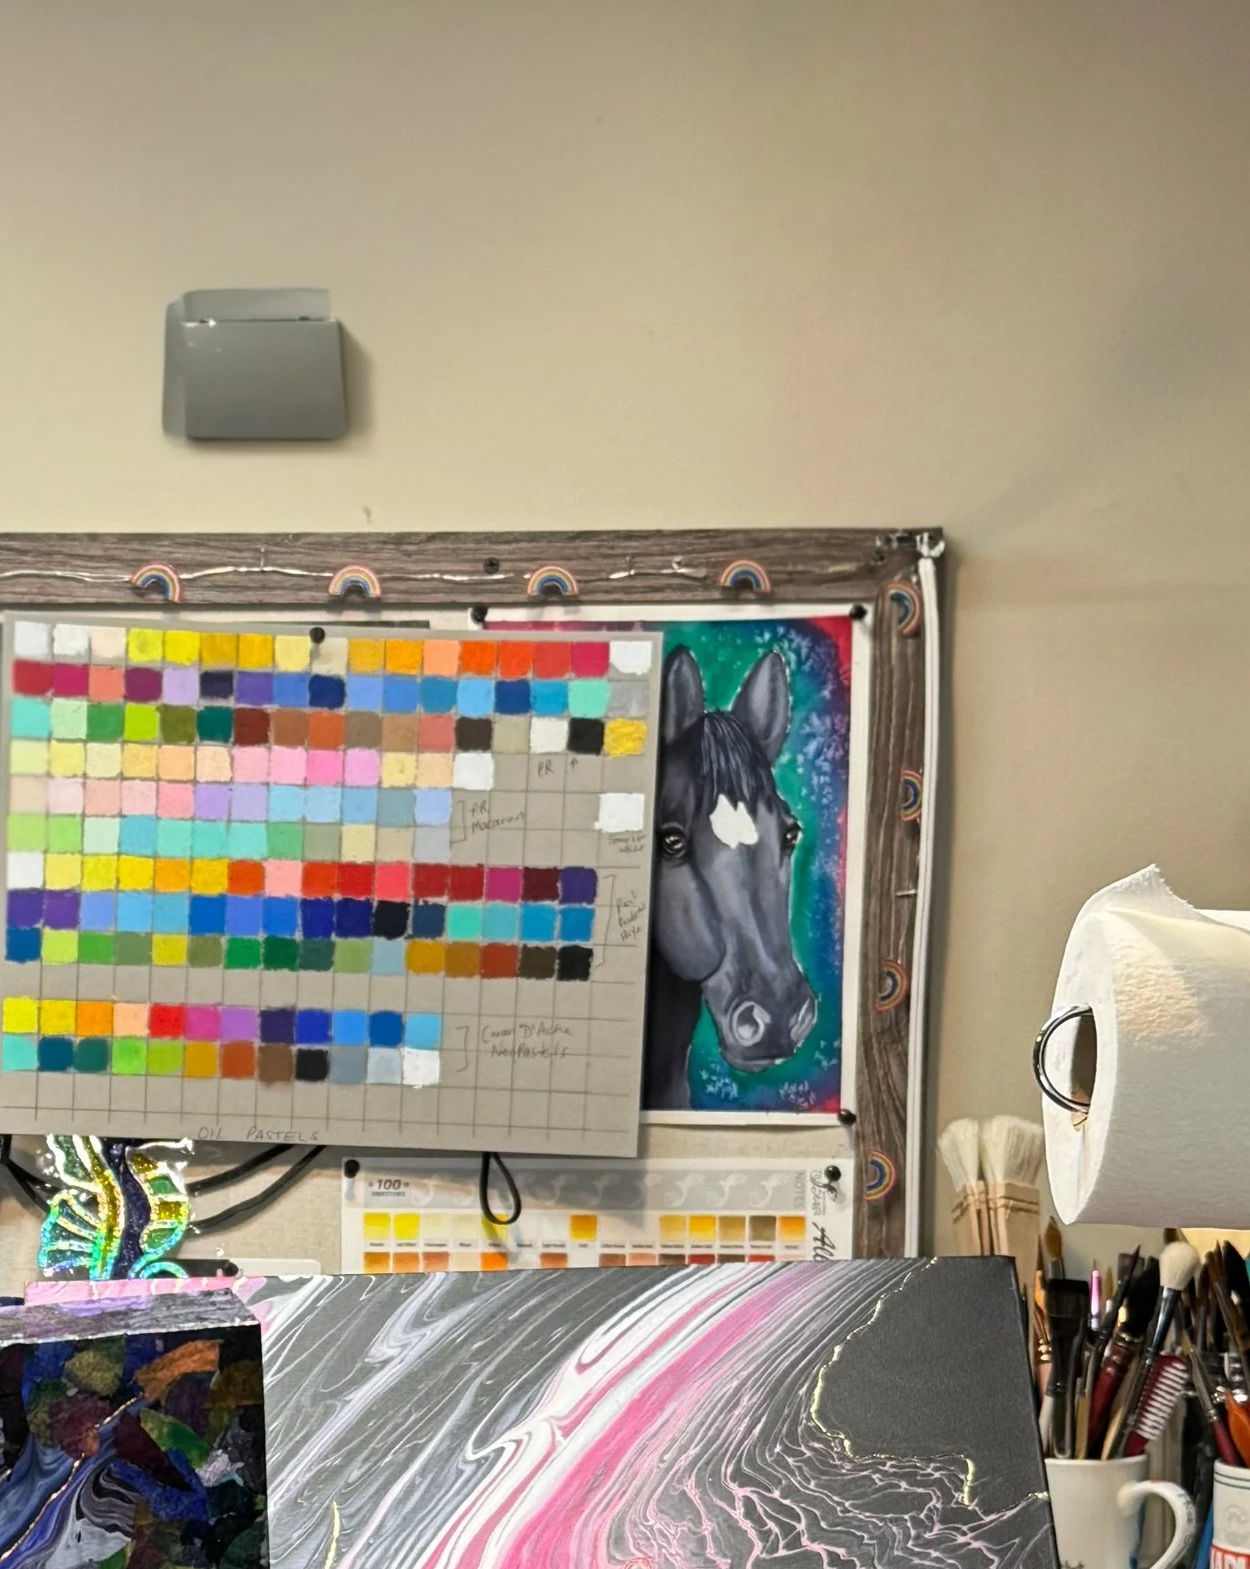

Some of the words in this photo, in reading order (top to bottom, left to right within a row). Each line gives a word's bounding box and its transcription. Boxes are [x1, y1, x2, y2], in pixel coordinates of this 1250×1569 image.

[197, 1126, 225, 1141] OIL
[246, 1126, 319, 1142] PASTELS
[377, 1178, 401, 1190] 100
